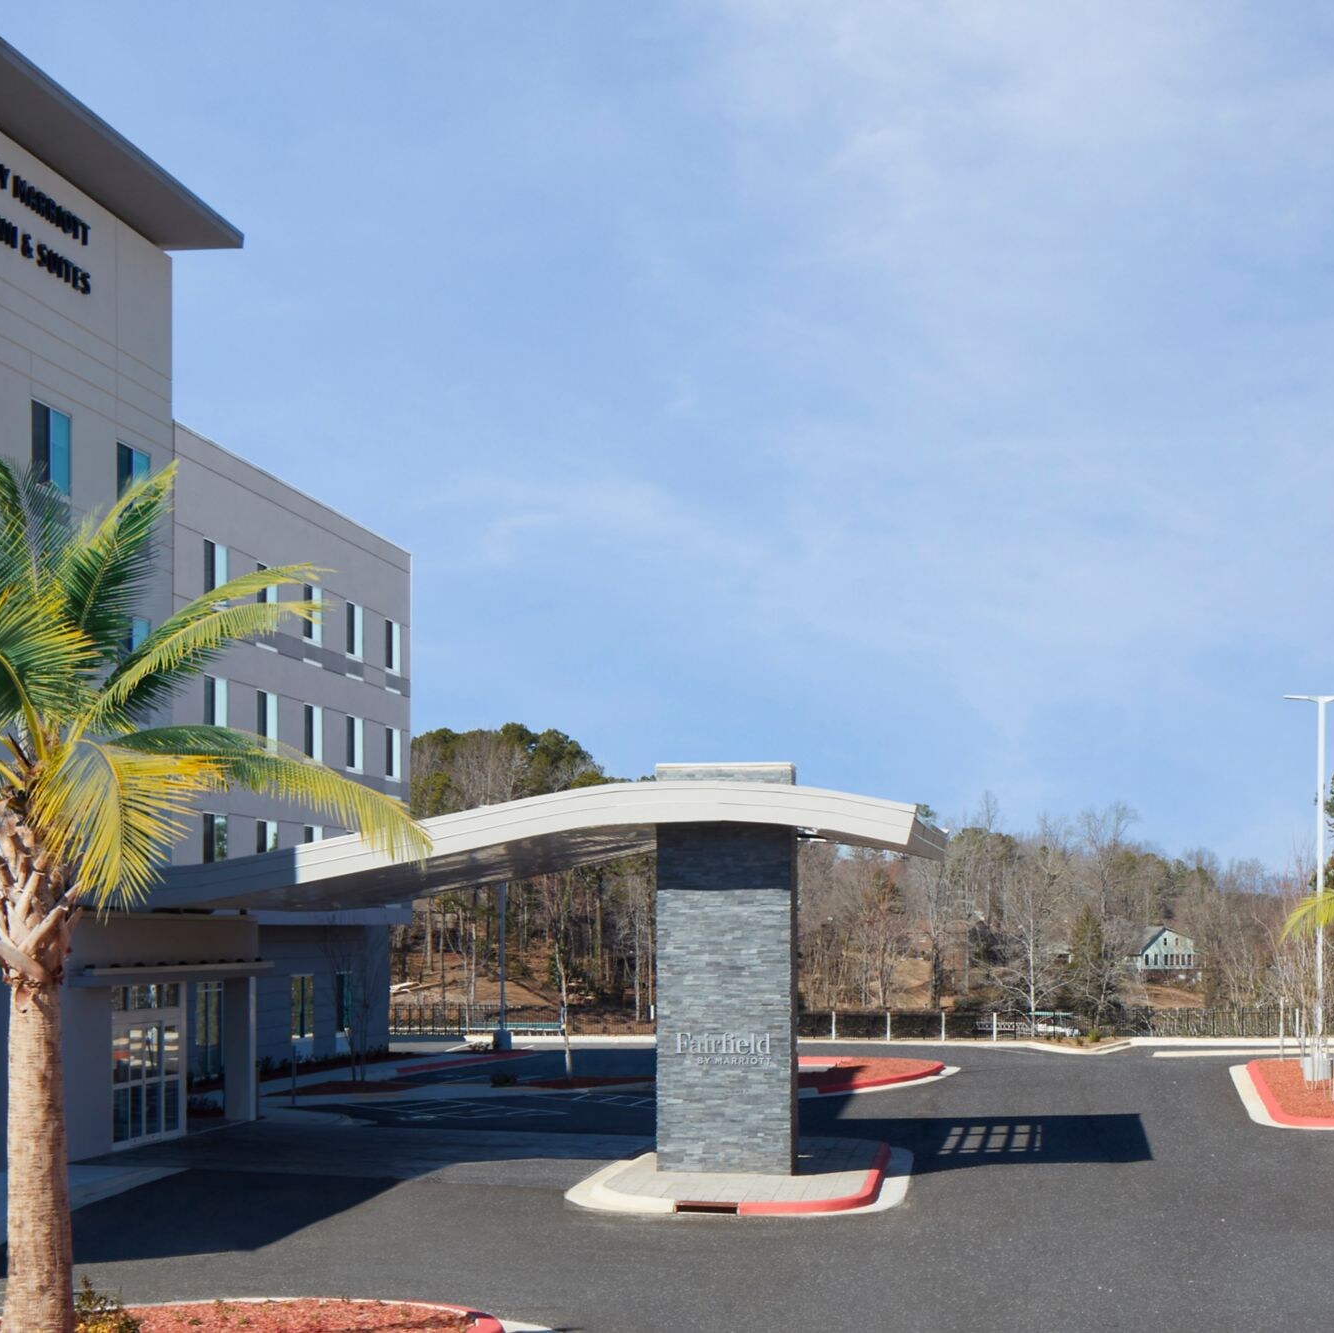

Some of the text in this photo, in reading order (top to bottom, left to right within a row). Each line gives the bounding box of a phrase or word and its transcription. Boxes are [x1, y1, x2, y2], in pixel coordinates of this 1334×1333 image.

[13, 175, 91, 246] MARRIOTT
[21, 233, 34, 259] &
[37, 243, 91, 295] SUITES
[675, 1032, 771, 1055] Fairfield
[697, 1057, 771, 1065] BY MARRIOTT
